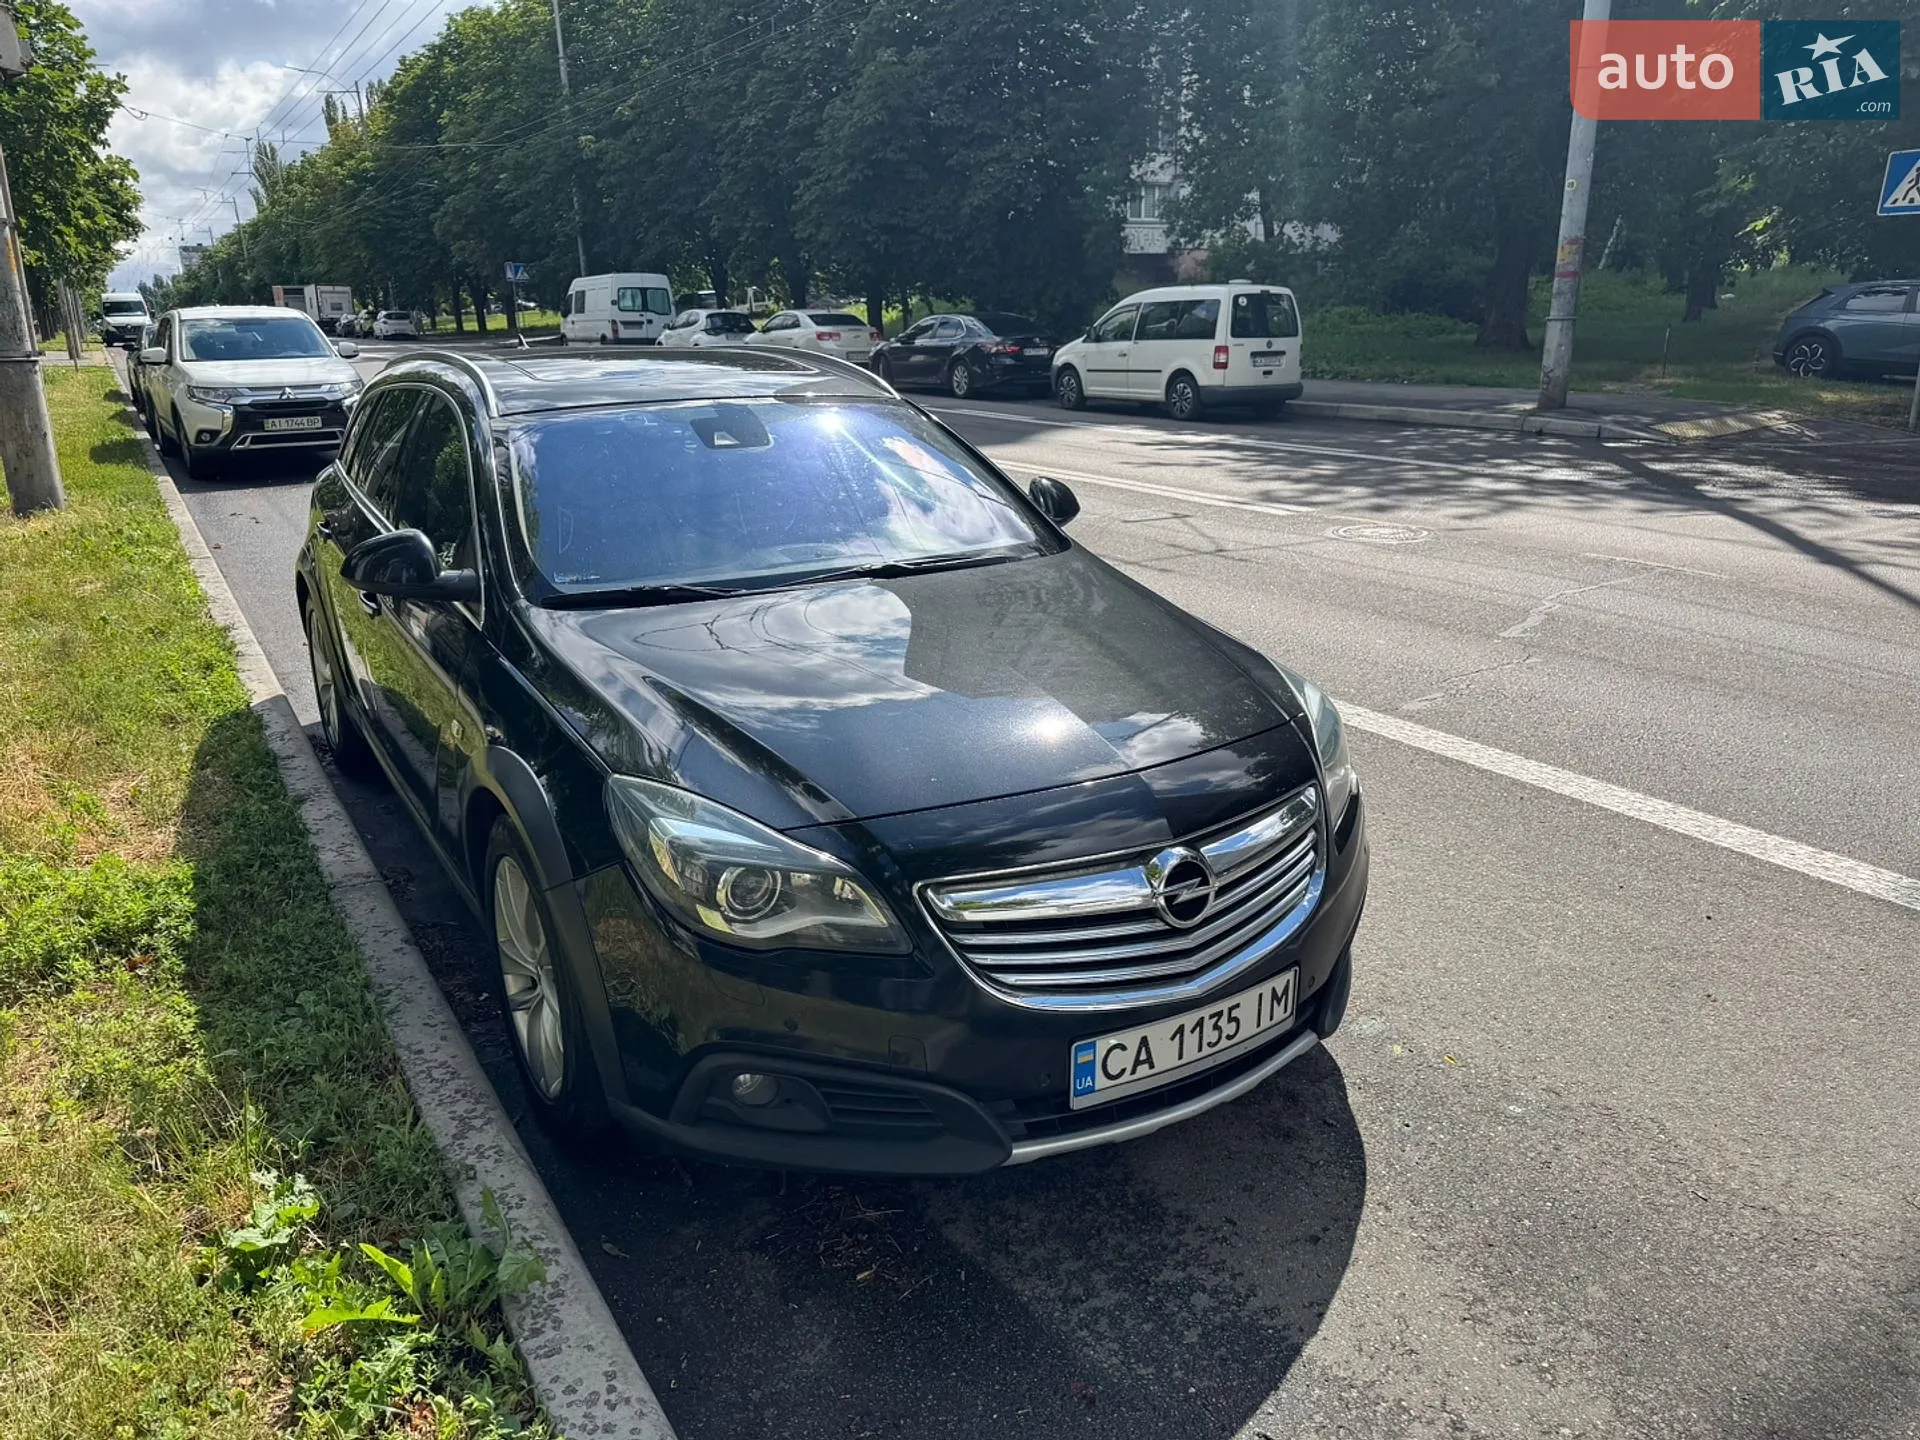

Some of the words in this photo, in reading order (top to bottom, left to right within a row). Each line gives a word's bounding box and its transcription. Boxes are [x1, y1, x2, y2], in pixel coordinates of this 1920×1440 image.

[286, 418, 305, 428] 1744
[1101, 1035, 1155, 1081] CA
[1169, 1002, 1241, 1061] 1135
[1256, 979, 1291, 1029] IM
[1076, 1077, 1093, 1090] UA
